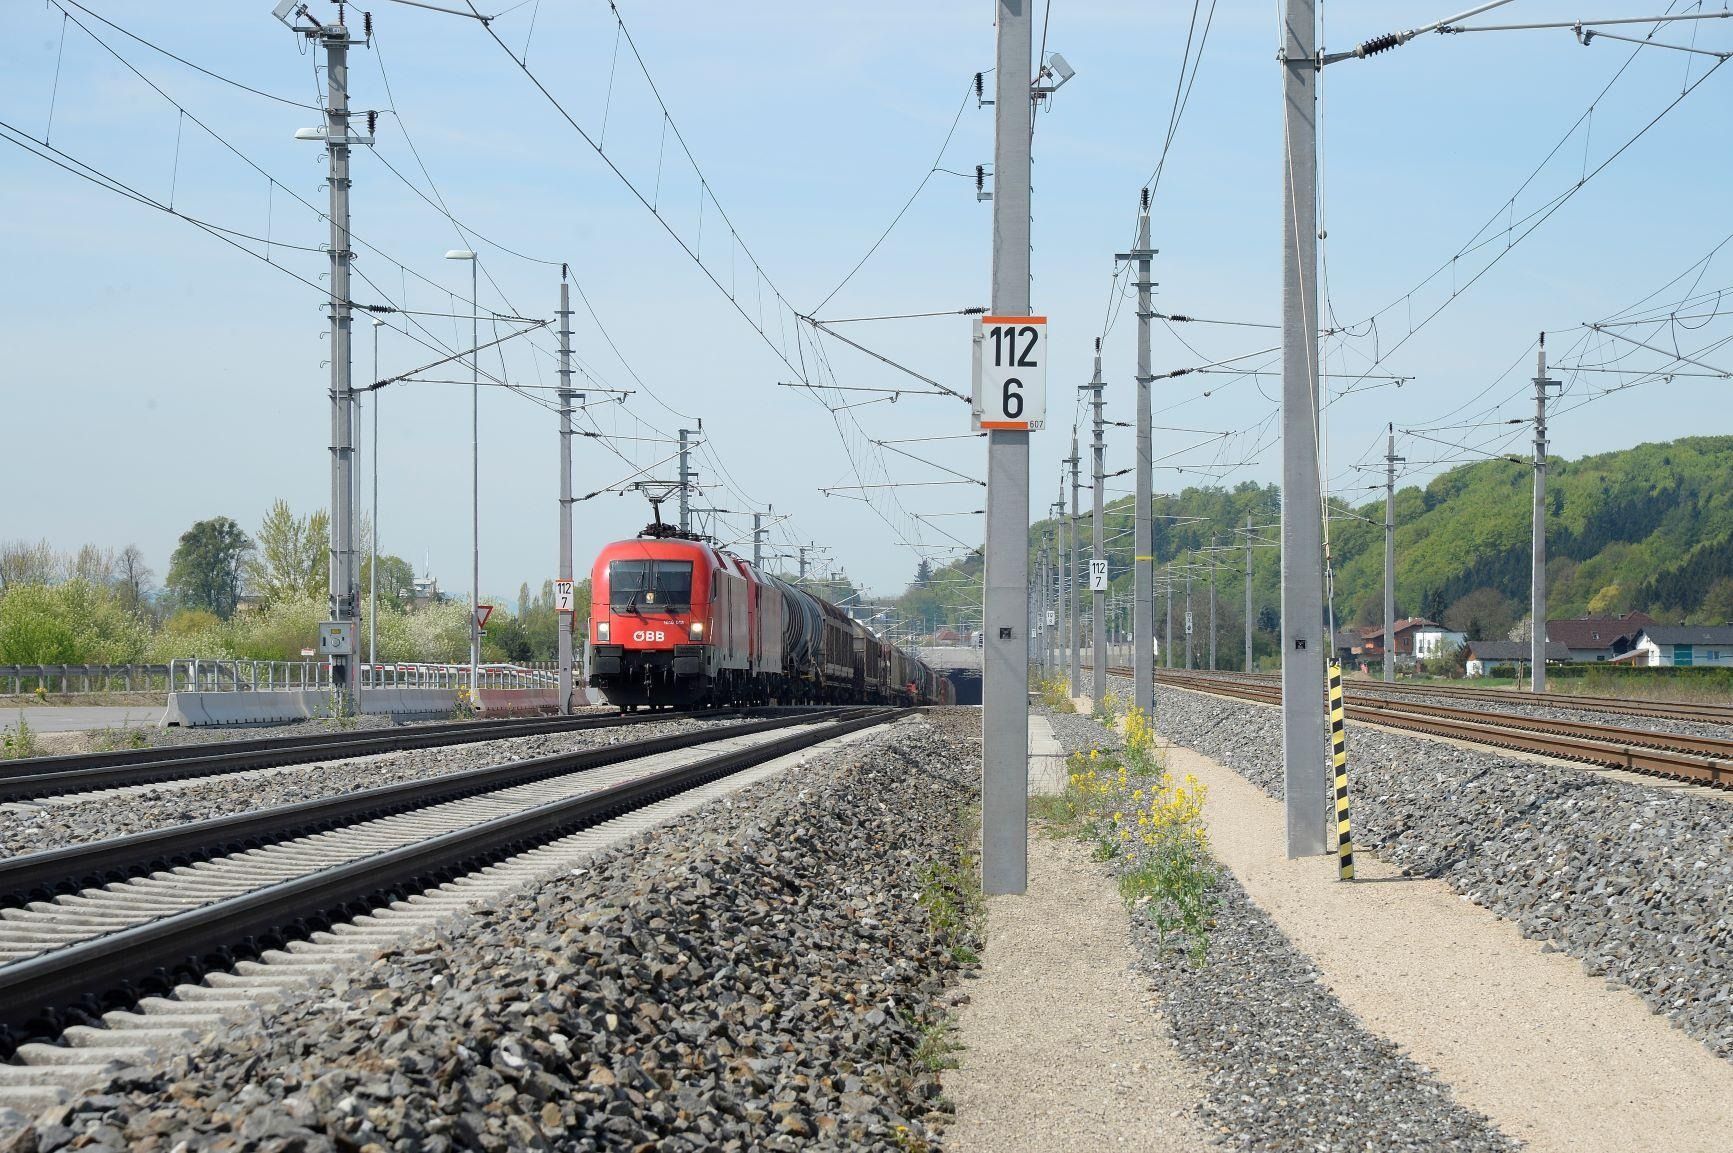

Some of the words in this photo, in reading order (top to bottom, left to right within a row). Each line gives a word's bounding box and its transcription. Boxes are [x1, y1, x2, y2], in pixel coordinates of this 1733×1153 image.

[990, 326, 1039, 367] 112
[1002, 377, 1024, 419] 6
[1029, 420, 1044, 429] 607
[1092, 562, 1106, 574] 112
[557, 582, 572, 595] 112
[1095, 576, 1102, 588] 7
[561, 596, 568, 609] 7
